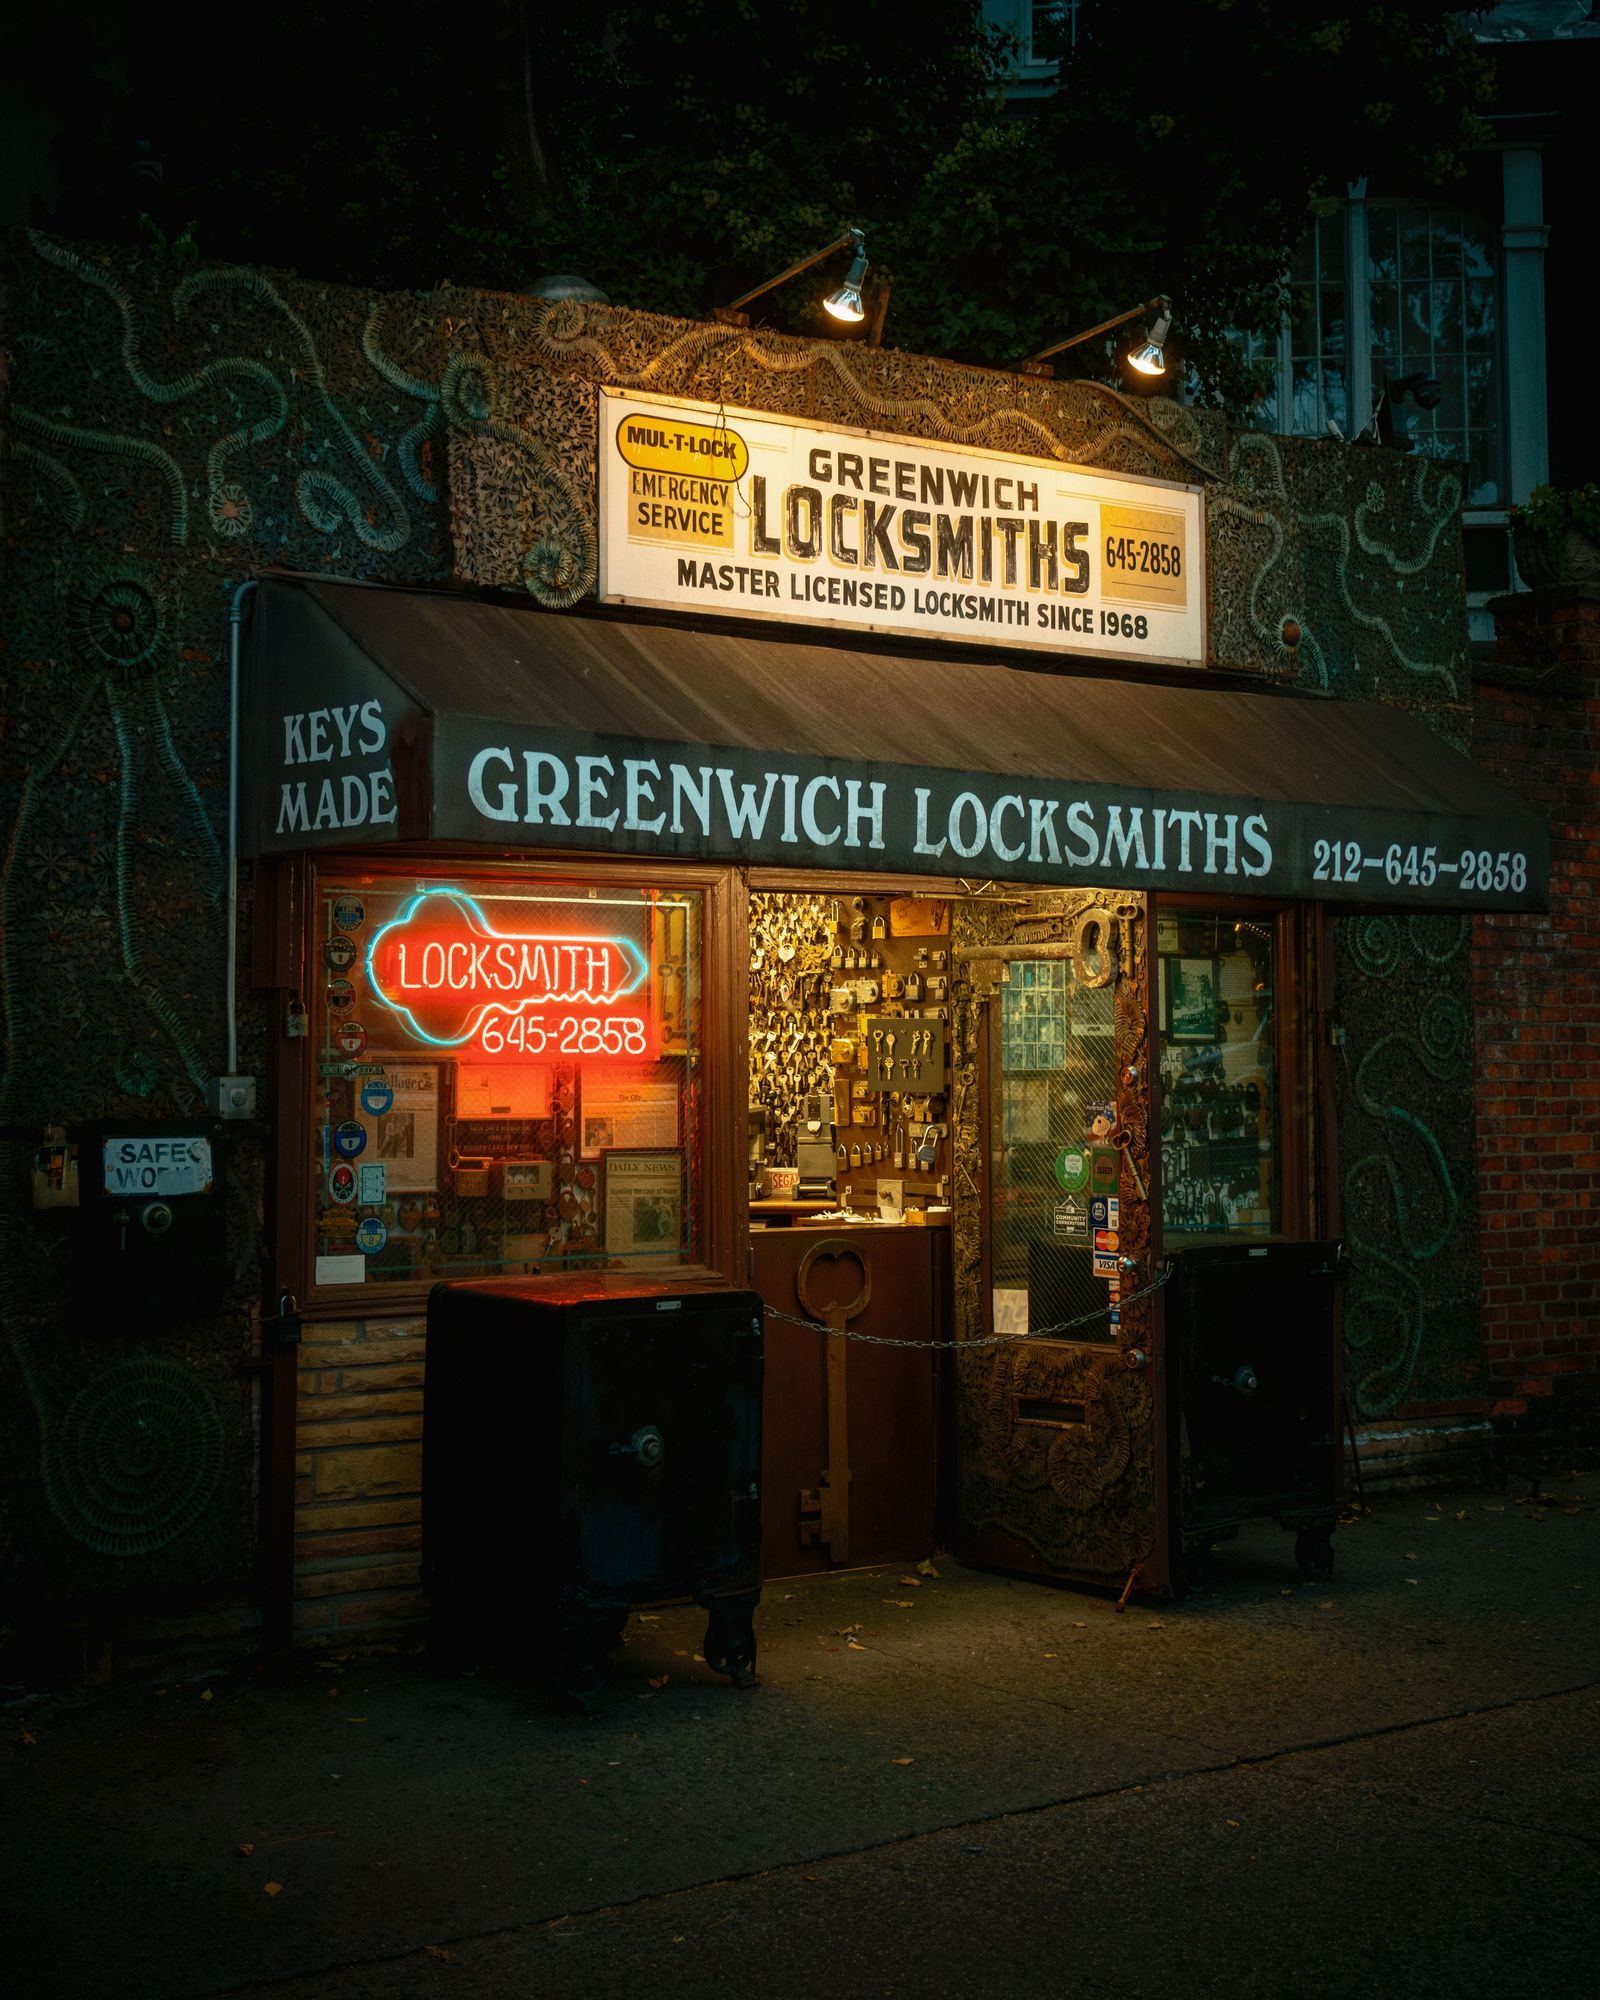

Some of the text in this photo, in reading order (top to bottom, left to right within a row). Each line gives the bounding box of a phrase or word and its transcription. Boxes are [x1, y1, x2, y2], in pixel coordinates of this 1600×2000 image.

[632, 470, 730, 508] EMERGENCY
[808, 447, 1039, 512] GREENWICH
[637, 501, 724, 536] SERVICE
[750, 474, 1090, 596] LOCKSMITHS
[1105, 535, 1182, 578] 645-2858
[677, 557, 1149, 640] MASTER LICENSED LOCKSMITH SINCE 1968
[283, 698, 388, 766] KEYS
[275, 767, 398, 835] MADE
[467, 746, 1273, 878] GREENWICH LOCKSMITHS
[1312, 838, 1528, 893] 212-645-2858
[399, 942, 610, 991] LOCKSMITH
[482, 1016, 647, 1055] 645-2858
[608, 1162, 676, 1172] DAILY NEWS
[1055, 1214, 1086, 1222] COMMUNITY
[1099, 1260, 1116, 1269] VISA
